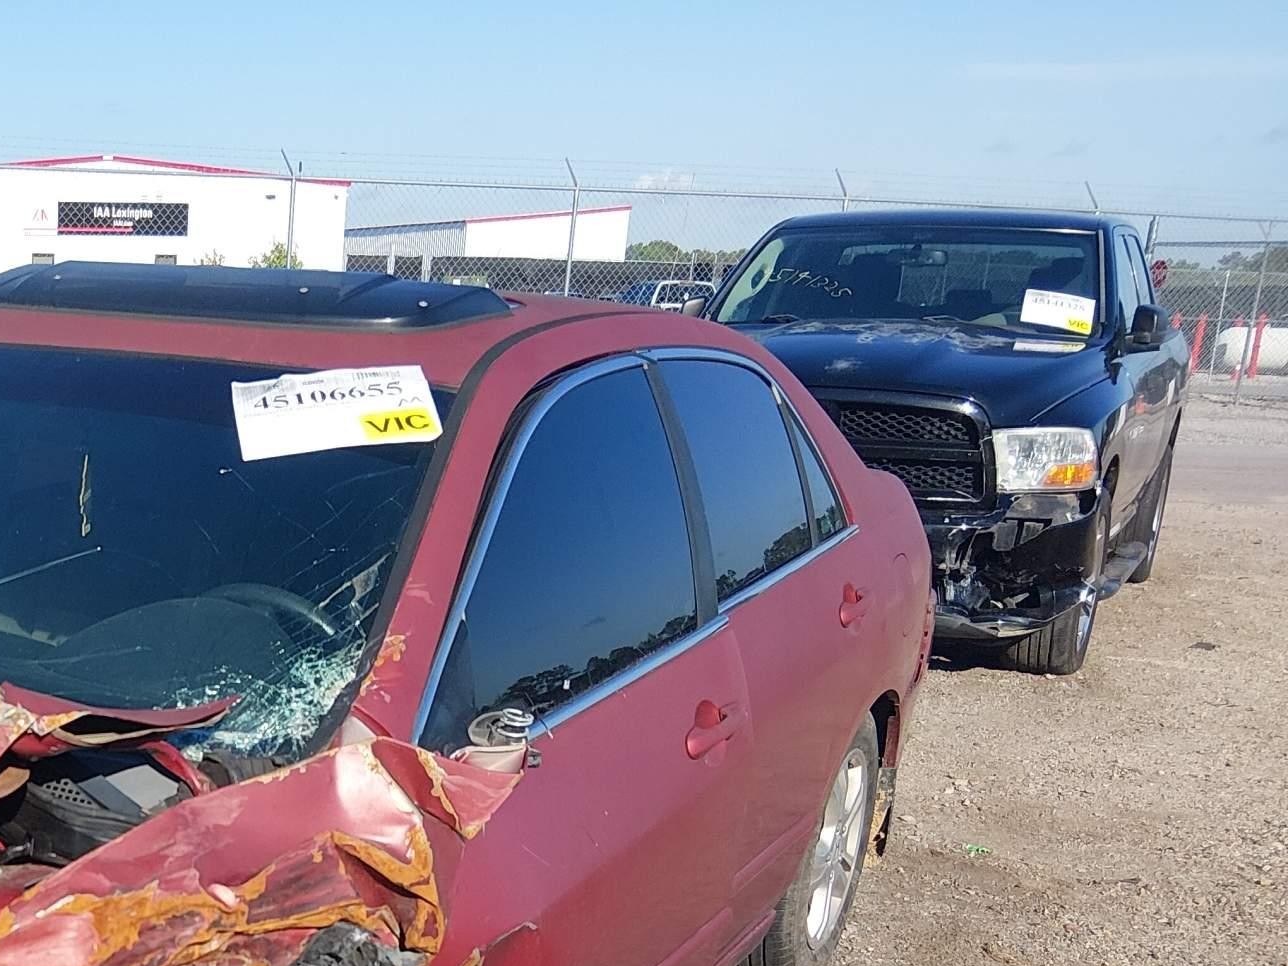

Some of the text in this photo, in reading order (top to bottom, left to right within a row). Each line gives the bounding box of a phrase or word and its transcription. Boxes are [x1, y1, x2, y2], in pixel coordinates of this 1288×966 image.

[93, 206, 111, 218] IAA
[1068, 319, 1090, 331] VIC
[253, 380, 403, 410] 45106655
[365, 414, 430, 433] VIC
